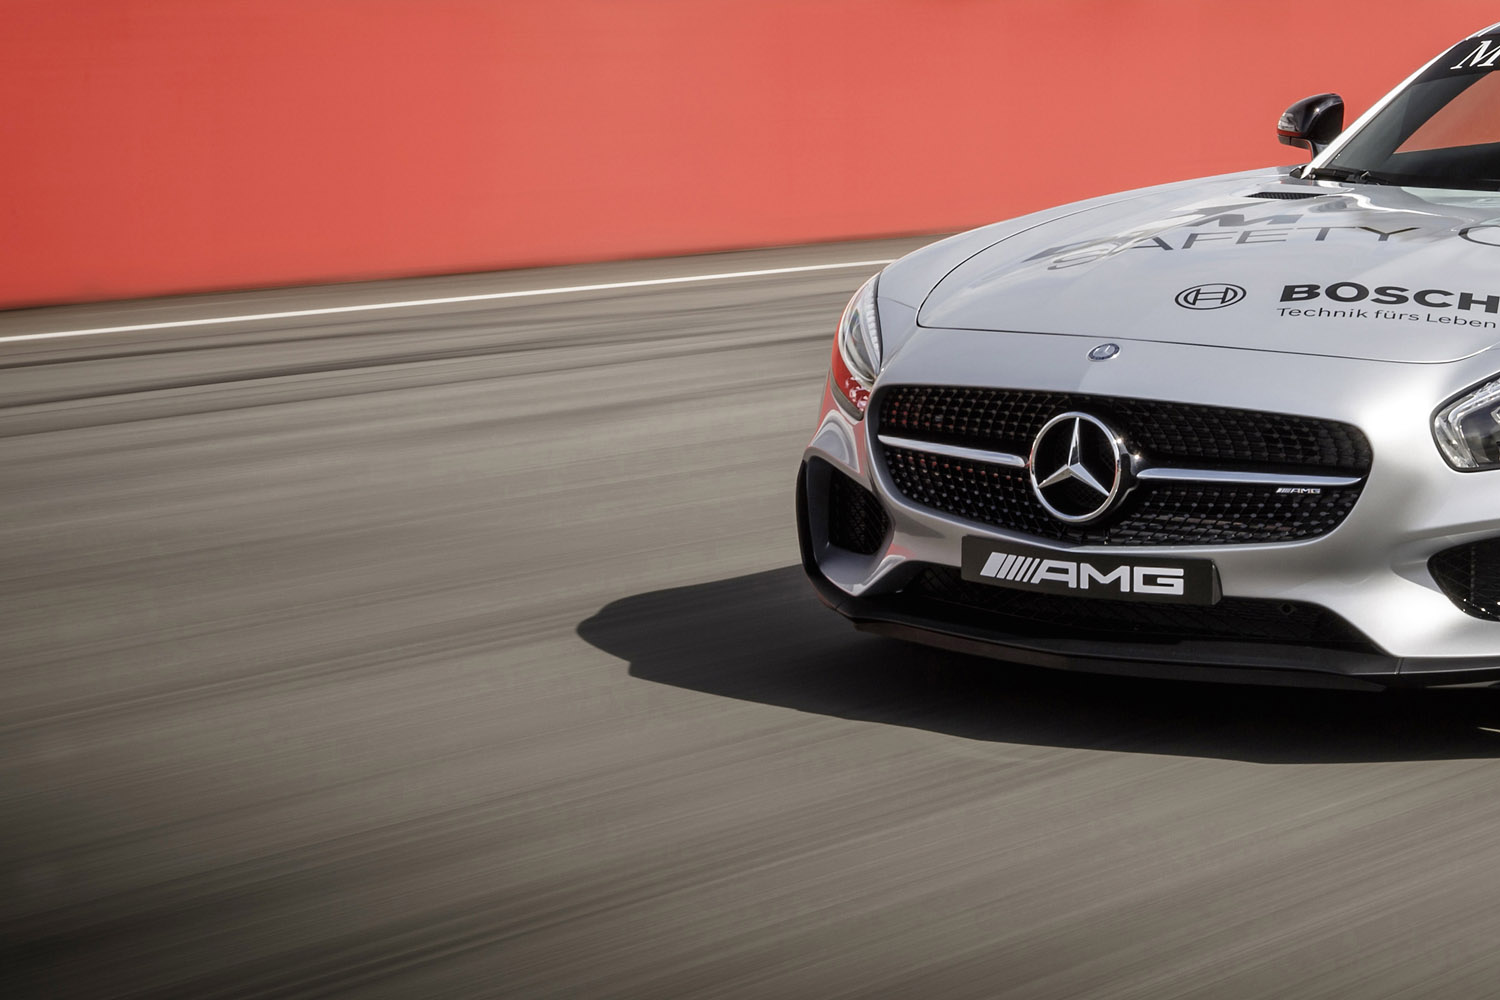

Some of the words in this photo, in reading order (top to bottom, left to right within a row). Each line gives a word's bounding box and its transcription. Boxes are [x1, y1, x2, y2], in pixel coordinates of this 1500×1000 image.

[1047, 226, 1418, 270] SAFETY
[1280, 281, 1500, 313] BOSCH
[1276, 307, 1368, 318] Technik
[1374, 310, 1420, 321] fürs
[1426, 313, 1497, 329] Leben
[1031, 558, 1184, 595] AMG
